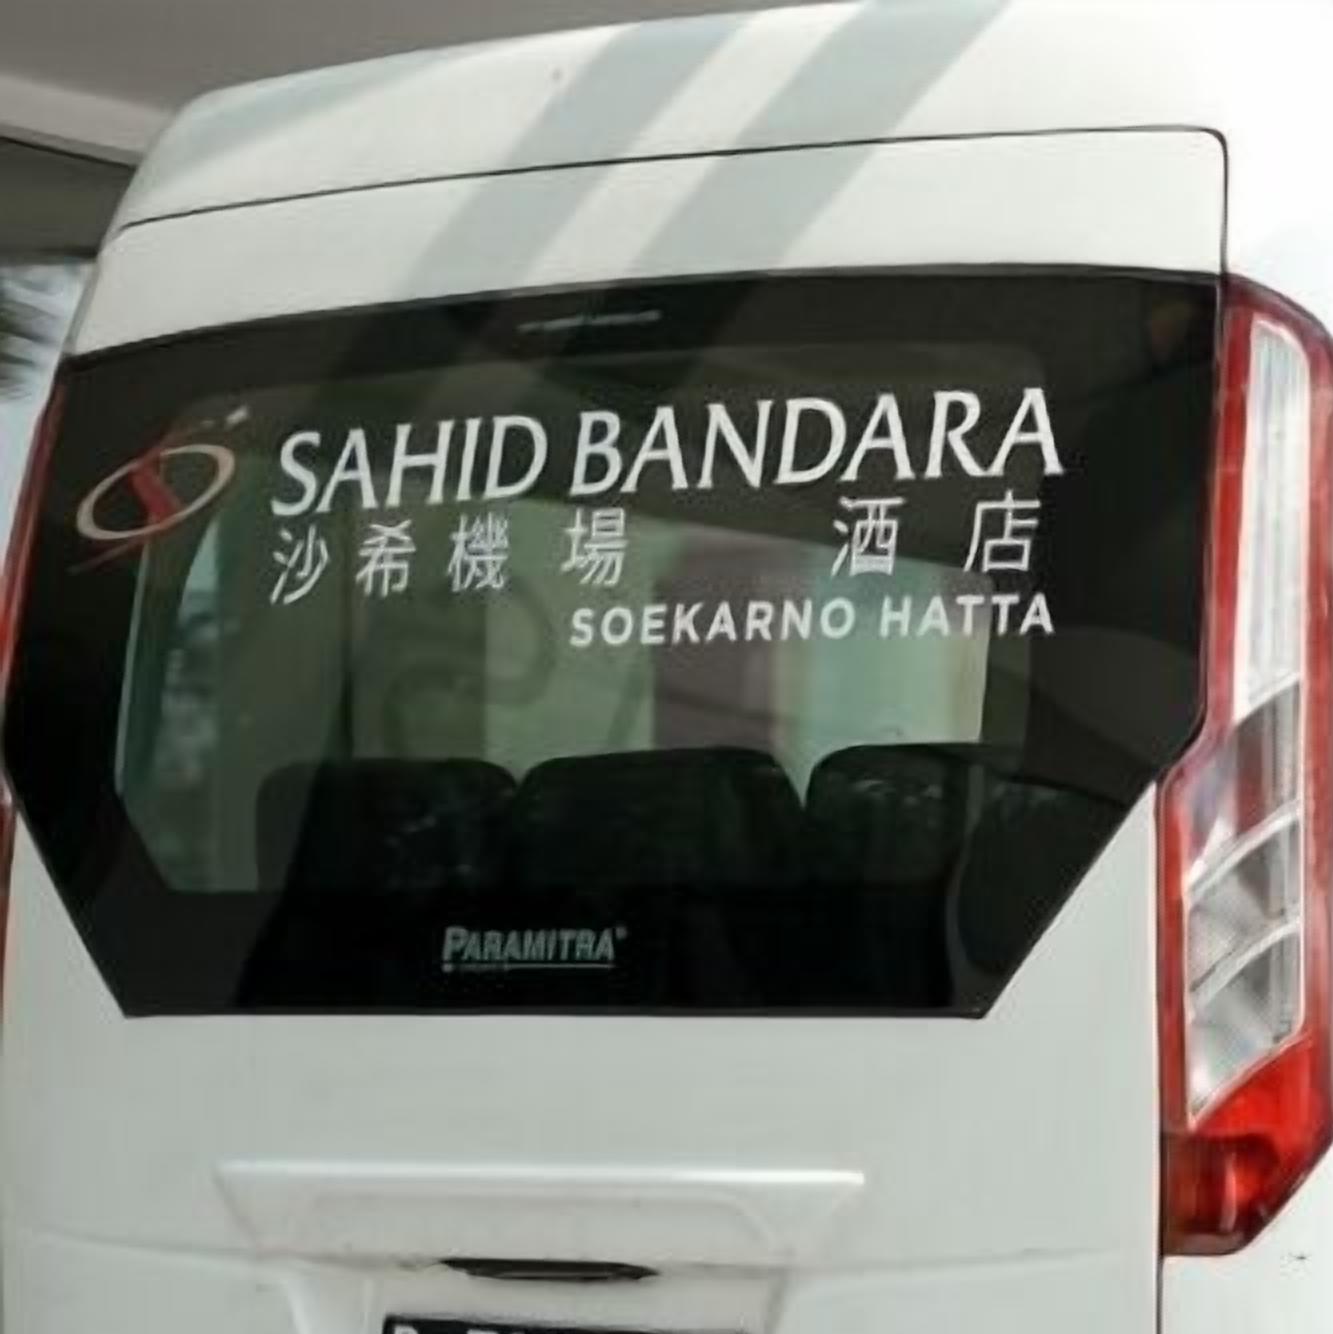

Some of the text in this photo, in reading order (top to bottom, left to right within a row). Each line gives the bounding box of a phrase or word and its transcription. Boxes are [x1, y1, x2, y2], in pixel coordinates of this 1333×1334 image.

[271, 387, 1064, 516] SAHID BANDARA
[270, 489, 1041, 604] 沙希機場 酒店
[569, 593, 1054, 648] SOEKARNO HATTA
